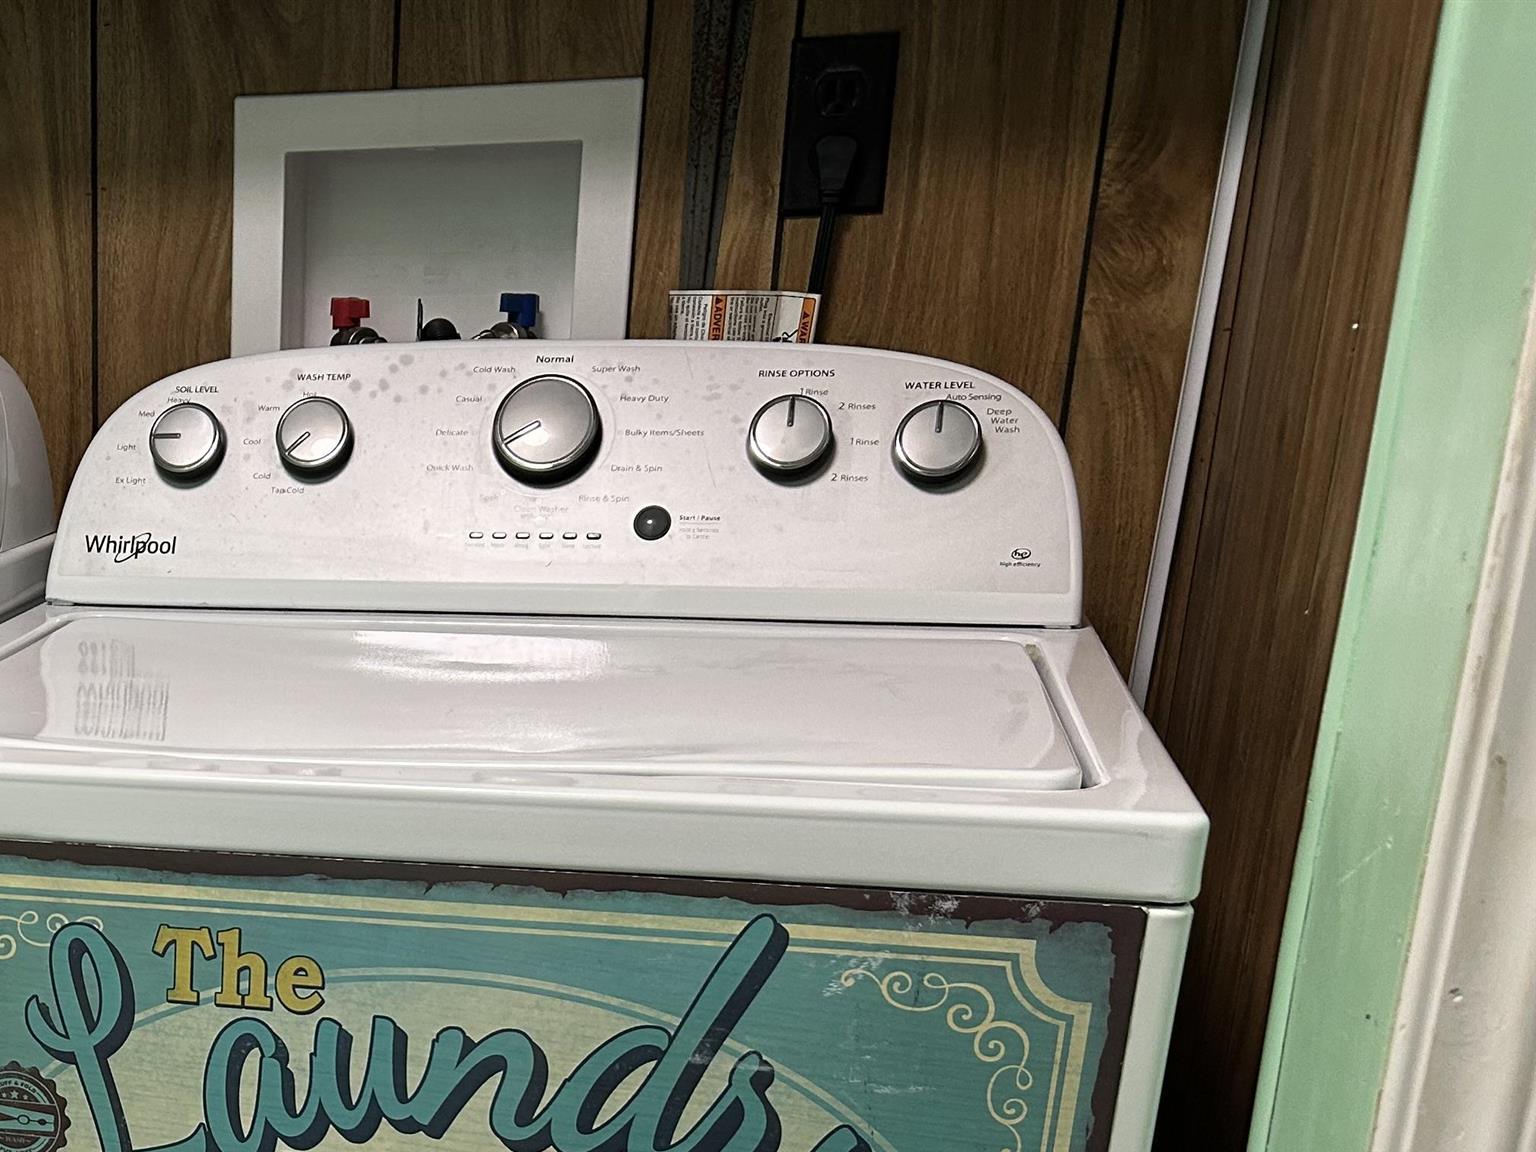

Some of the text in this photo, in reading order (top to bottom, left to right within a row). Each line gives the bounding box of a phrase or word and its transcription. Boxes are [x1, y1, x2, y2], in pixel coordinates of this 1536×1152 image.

[535, 355, 575, 364] Normal
[592, 365, 616, 374] Super
[758, 369, 836, 378] RINSE OPTIONS
[297, 373, 352, 382] WASH TEMP
[175, 386, 219, 394] SOIL LEVEL
[904, 381, 976, 390] WATER LEVEL
[805, 388, 829, 396] Rinse
[620, 395, 670, 403] Heavy Duty
[968, 393, 1002, 402] Sensing
[838, 402, 876, 410] 2 Rinses
[138, 410, 156, 418] Med
[986, 408, 1012, 416] Deep
[624, 429, 648, 437] Bulky
[994, 426, 1020, 434] Wash
[243, 438, 262, 446] Cool
[856, 438, 880, 446] Rinse
[116, 443, 136, 452] Light
[643, 464, 663, 473] Spin
[253, 472, 272, 480] Cold
[830, 473, 869, 482] 2 Rinses
[128, 476, 146, 486] Light
[85, 533, 176, 562] Whirlpool
[153, 925, 326, 1014] The
